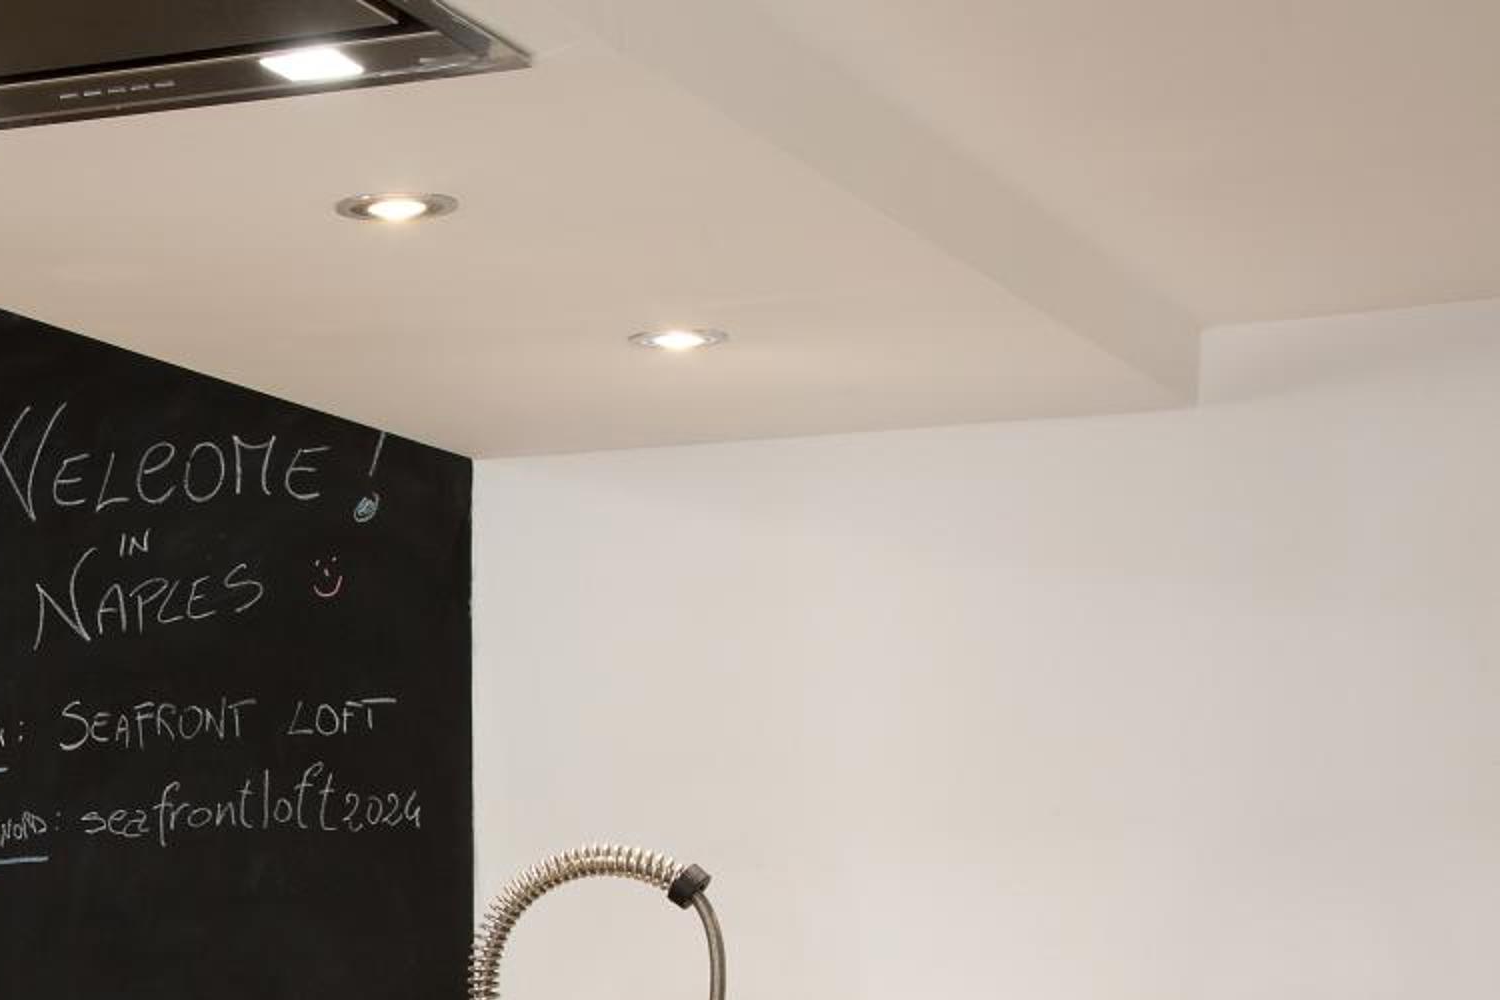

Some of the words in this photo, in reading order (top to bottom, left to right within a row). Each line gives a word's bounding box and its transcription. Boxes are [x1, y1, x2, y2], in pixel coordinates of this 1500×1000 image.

[120, 528, 150, 558] IN
[33, 546, 264, 651] NAPLES
[59, 699, 257, 750] SEAFRONT
[287, 697, 397, 736] LOFT
